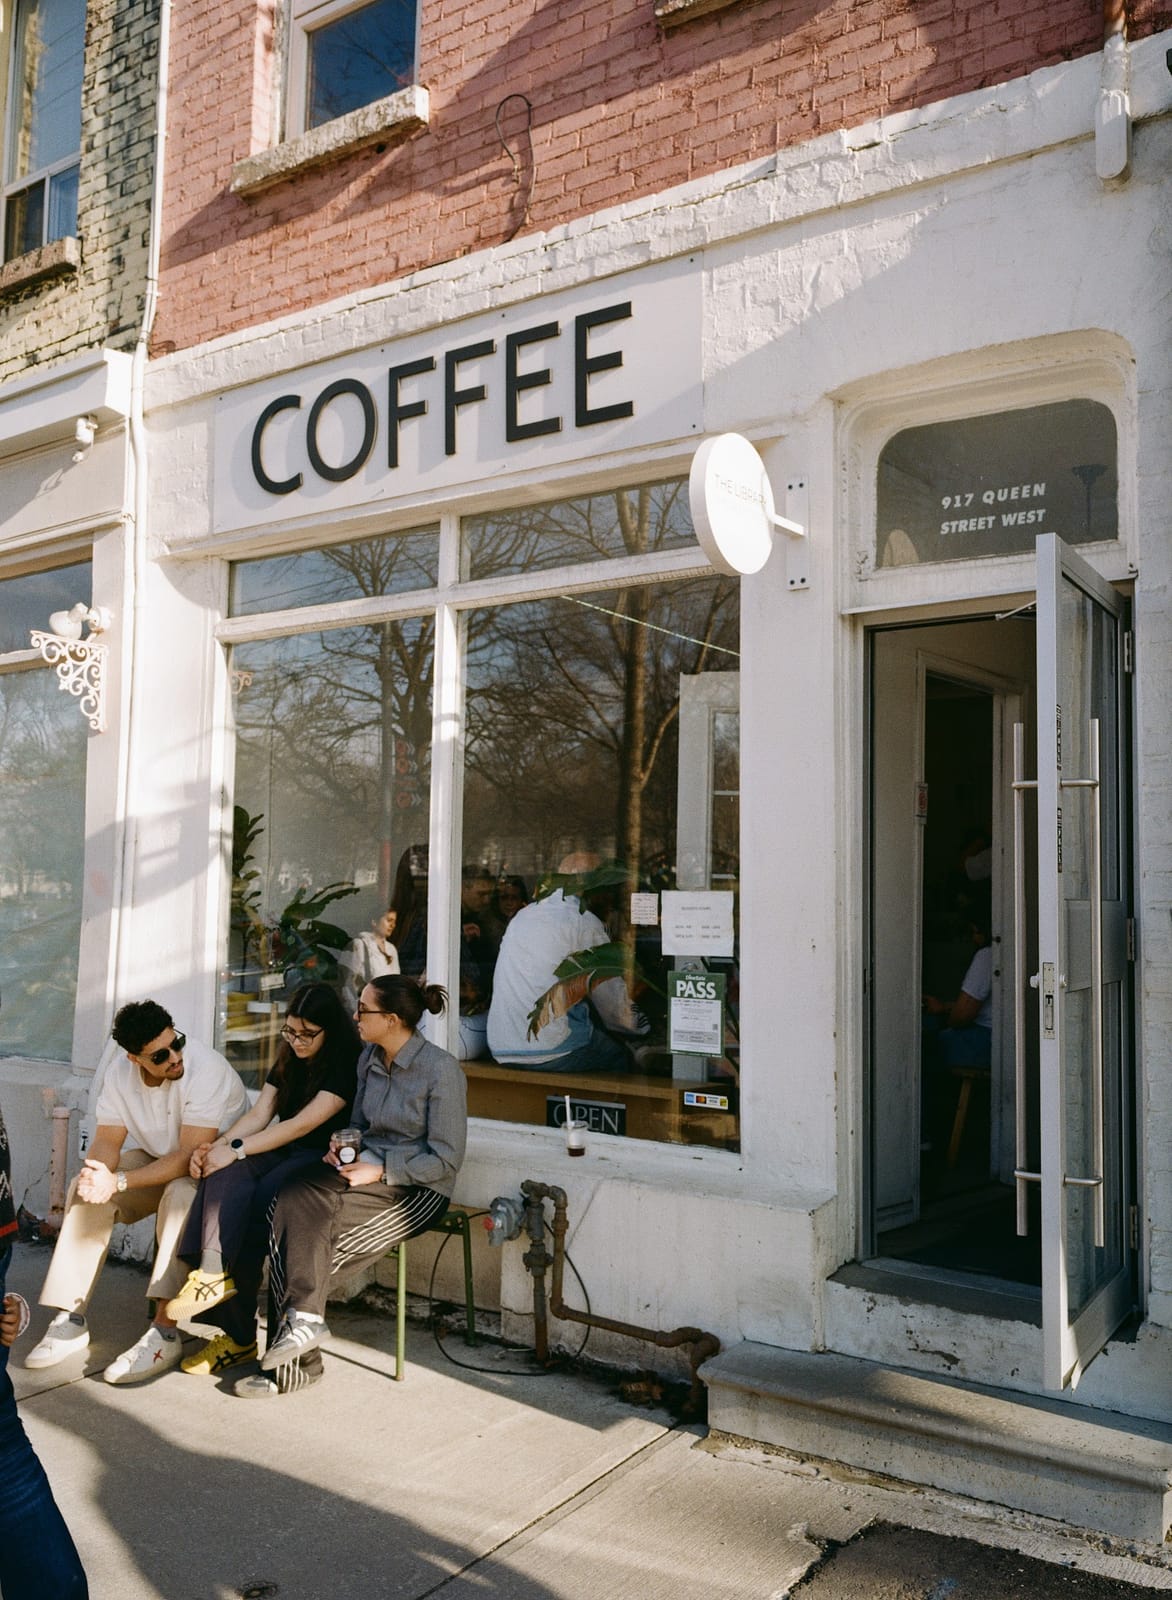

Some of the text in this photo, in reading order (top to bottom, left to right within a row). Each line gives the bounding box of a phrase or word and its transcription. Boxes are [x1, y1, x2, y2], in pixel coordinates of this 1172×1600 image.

[251, 301, 634, 494] COFFEE
[941, 483, 1047, 510] 917 QUEEN
[940, 509, 1046, 535] STREET WEST
[676, 980, 716, 999] PASS
[553, 1103, 619, 1134] OPEN
